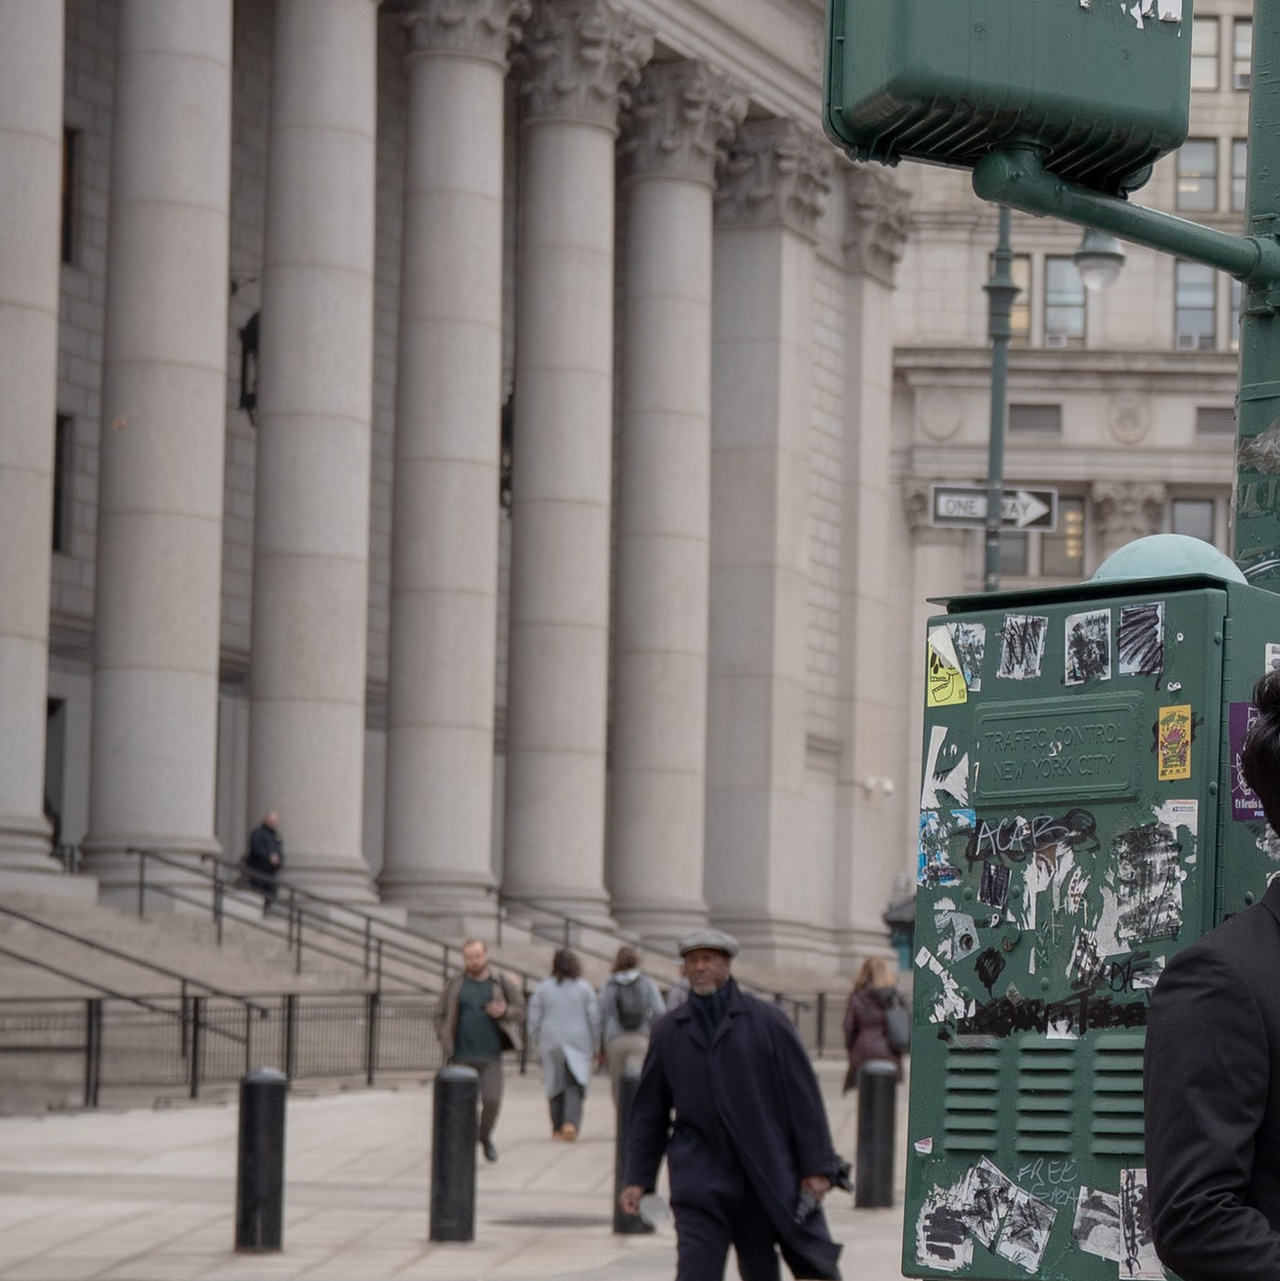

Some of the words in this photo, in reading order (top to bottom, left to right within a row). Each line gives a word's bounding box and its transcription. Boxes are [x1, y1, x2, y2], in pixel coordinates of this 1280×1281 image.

[945, 499, 978, 516] ONE
[985, 728, 1048, 752] TRAFFIC
[1052, 722, 1126, 746] CONTROL
[993, 761, 1026, 782] NEW
[1032, 756, 1073, 779] YORK
[1077, 753, 1116, 776] CITY
[976, 815, 1070, 856] ACAB
[1016, 1157, 1079, 1184] FREE
